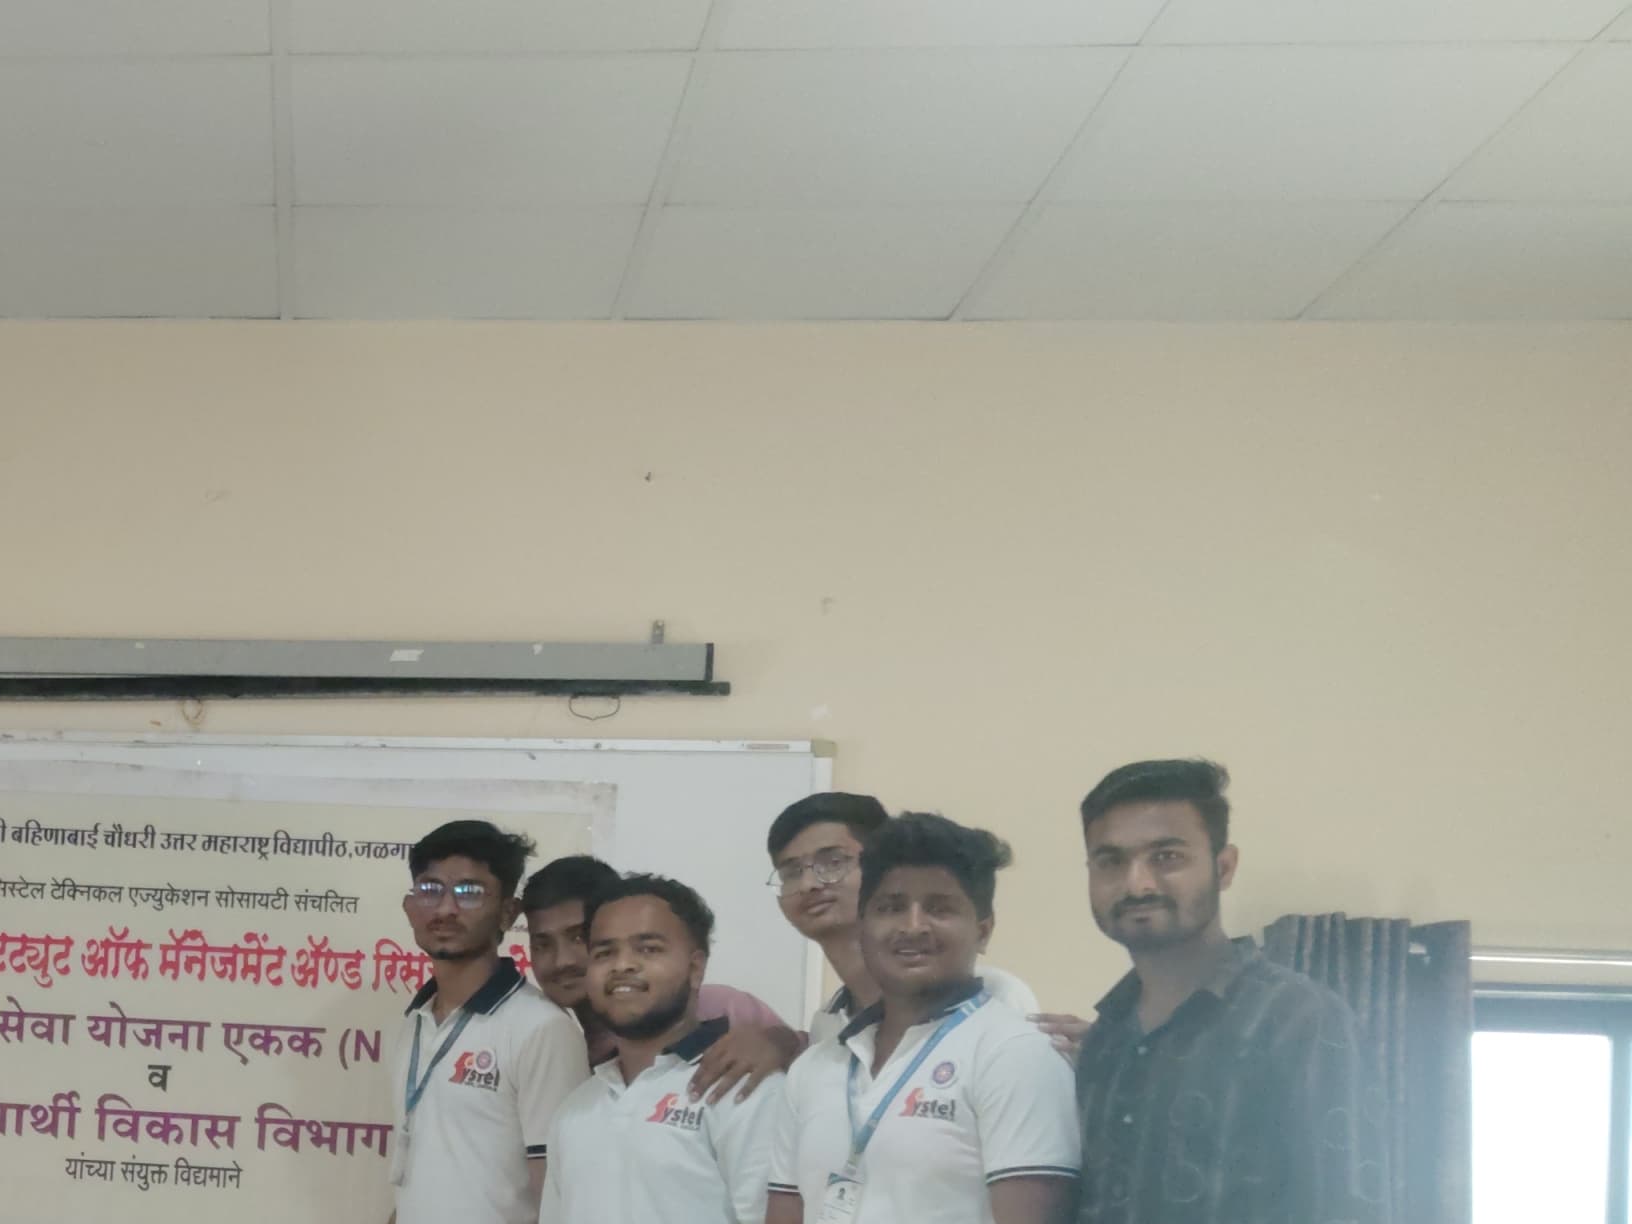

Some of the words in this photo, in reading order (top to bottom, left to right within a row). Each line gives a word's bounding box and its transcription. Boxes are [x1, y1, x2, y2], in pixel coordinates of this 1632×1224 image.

[11, 819, 101, 850] बहिणाबाई
[103, 823, 156, 849] चौधरी
[160, 832, 198, 851] उत्तर
[201, 834, 270, 860] महाराष्ट्र
[50, 877, 123, 904] टेक्निकल
[128, 882, 210, 912] एज्युकेशन
[215, 884, 289, 912] सोसायटी
[294, 888, 360, 914] संचलित
[81, 925, 153, 981] ऑफ
[372, 938, 435, 994] रिस
[86, 1001, 211, 1052] योजना
[221, 1022, 326, 1066] एकक
[147, 1063, 172, 1092] व
[94, 1093, 241, 1149] विकास
[255, 1102, 394, 1158] विभाग
[65, 1151, 116, 1182] यांच्या
[121, 1154, 170, 1192] संयुक्त
[174, 1156, 243, 1189] विद्यमाने
